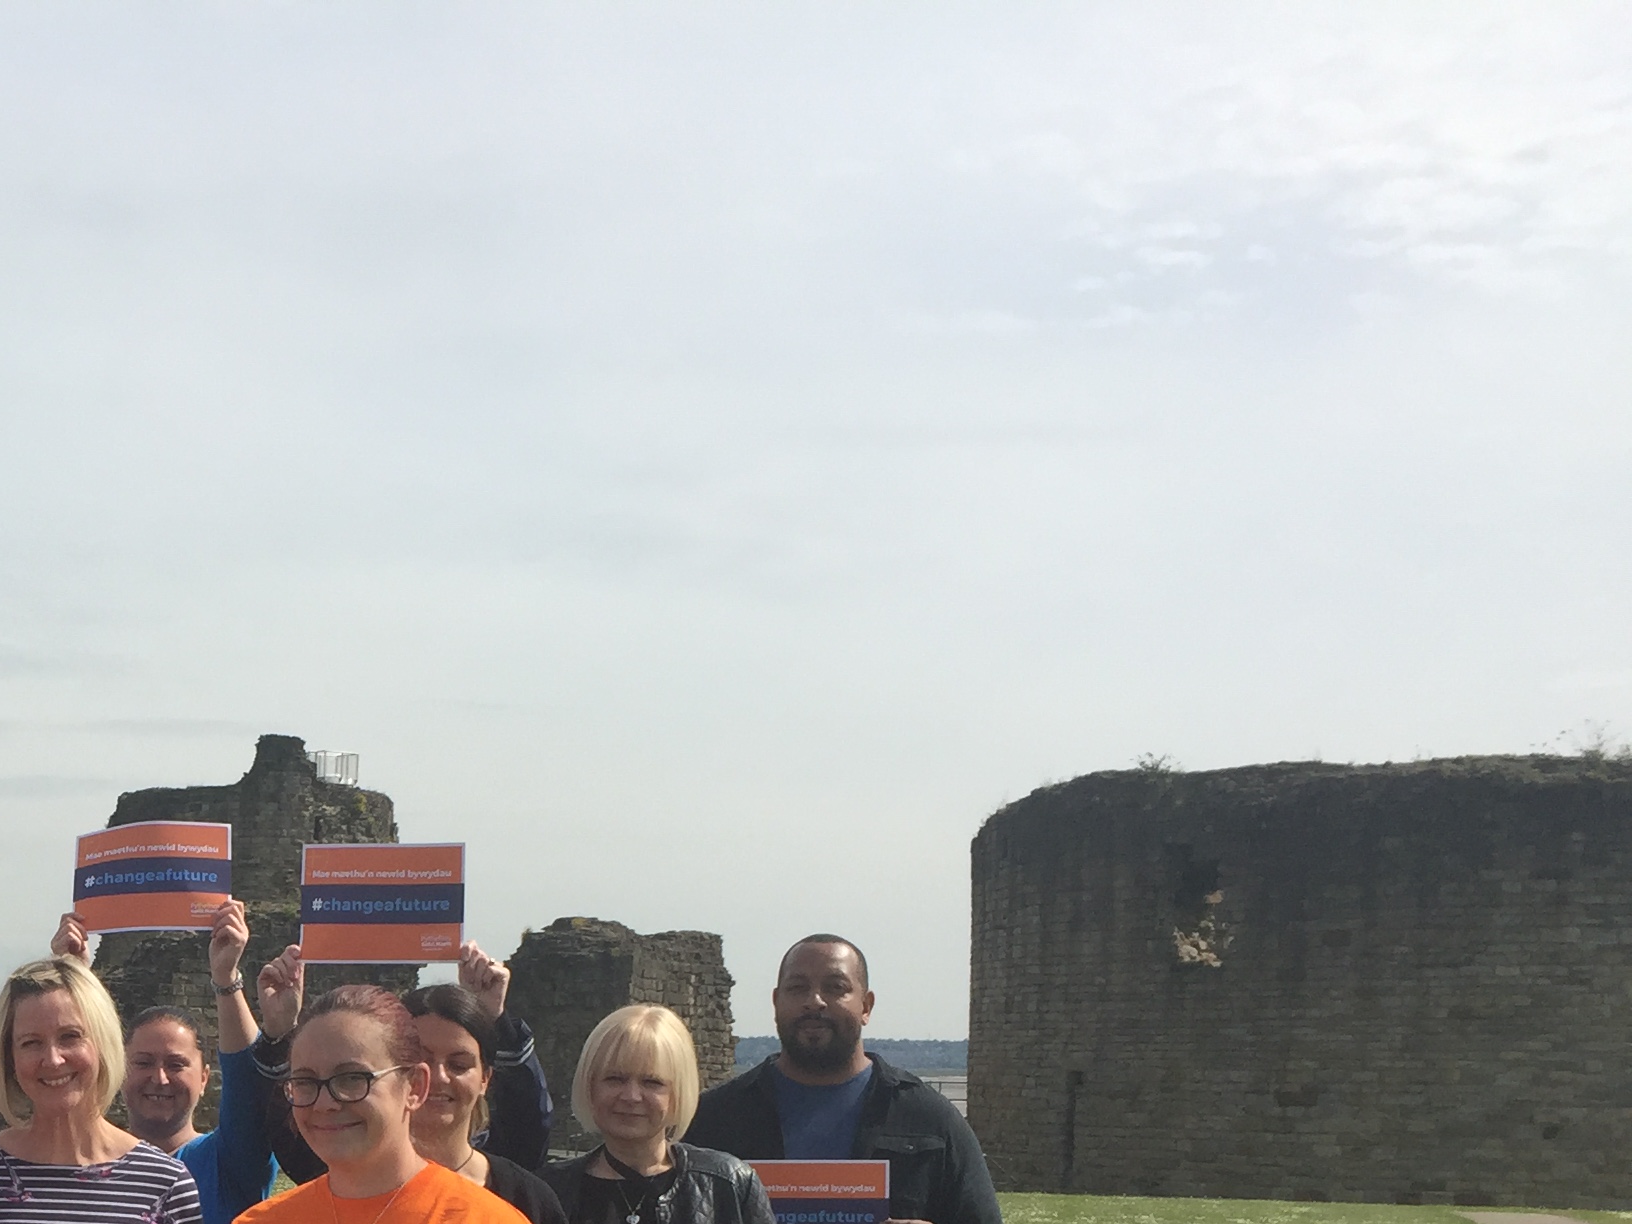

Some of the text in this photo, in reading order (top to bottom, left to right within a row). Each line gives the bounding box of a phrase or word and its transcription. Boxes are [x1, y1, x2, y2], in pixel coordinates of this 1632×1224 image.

[147, 843, 176, 851] newid
[84, 868, 218, 888] #changeafuture
[311, 897, 450, 914] #changeafuture
[831, 1184, 875, 1193] bywydau
[775, 1210, 875, 1224] ngeafuture
